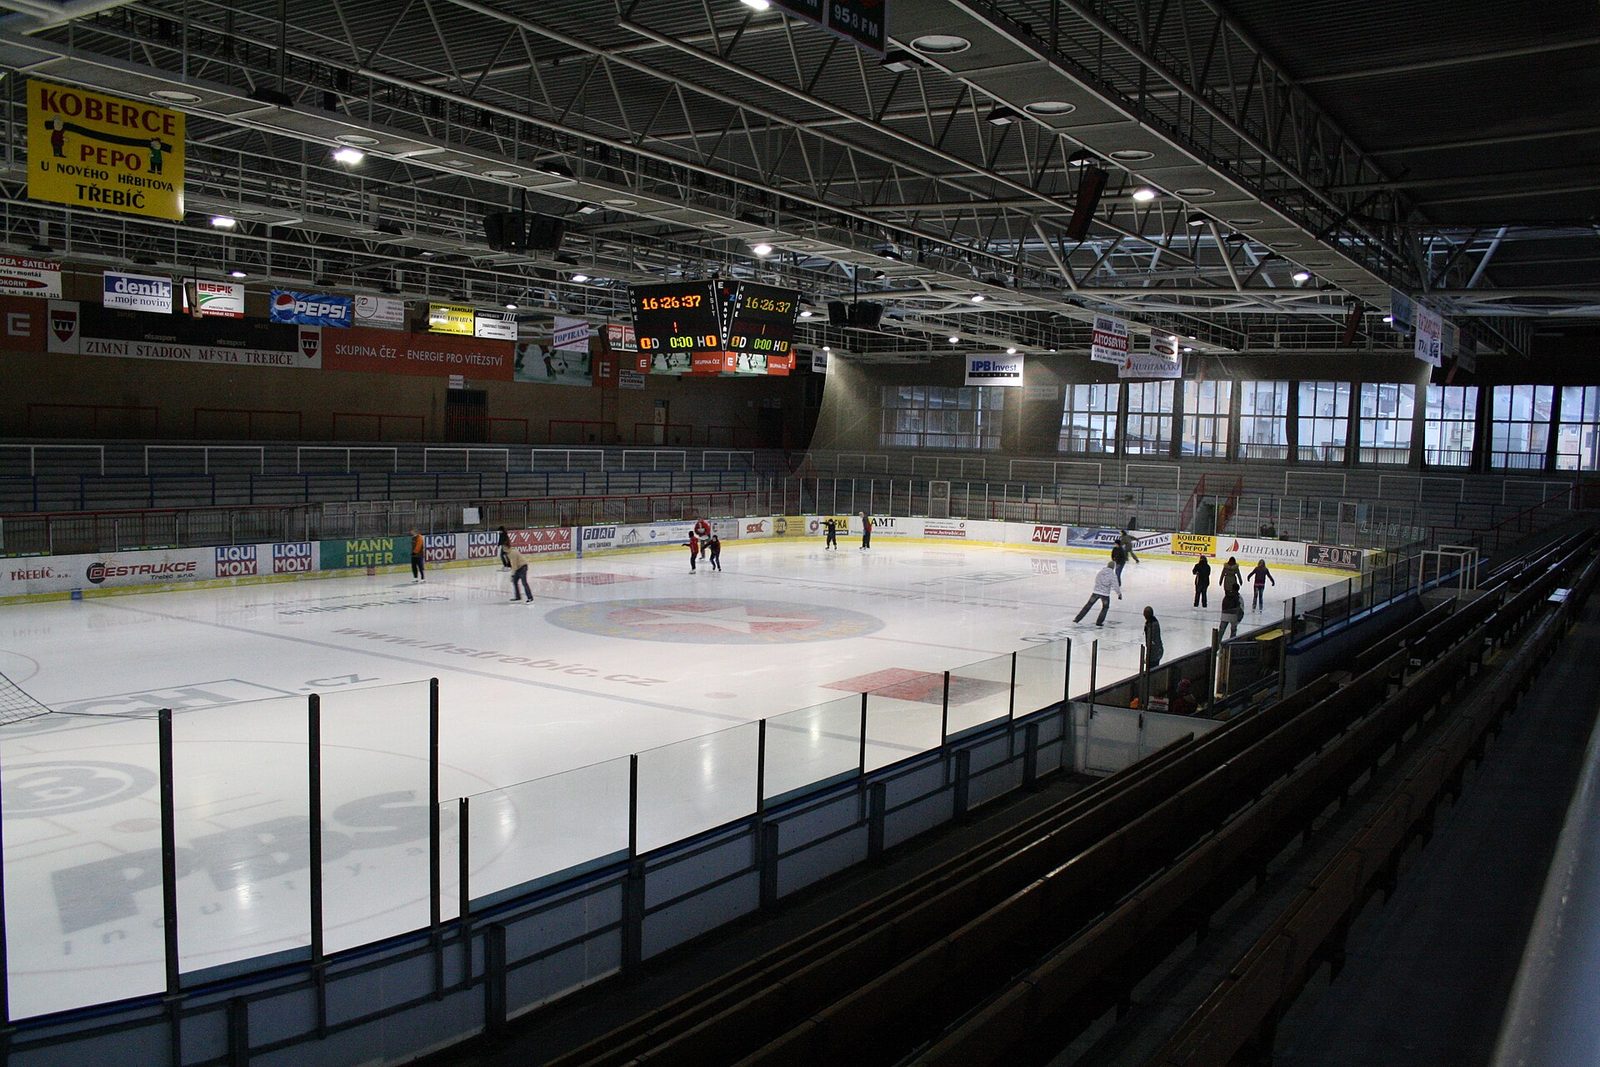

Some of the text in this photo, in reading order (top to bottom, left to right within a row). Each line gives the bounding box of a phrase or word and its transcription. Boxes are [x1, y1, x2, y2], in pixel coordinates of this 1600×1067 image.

[861, 18, 878, 38] FM
[40, 88, 176, 136] KOBERCE
[80, 144, 141, 170] PEPO
[40, 161, 174, 192] U NOVÉHO HŘBITOVA
[76, 184, 146, 208] TŘEBÍČ
[22, 260, 60, 270] SATELITY
[115, 278, 170, 298] deník
[140, 298, 172, 309] noviny
[630, 290, 638, 320] HOME
[642, 296, 701, 310] 16:26:37
[708, 284, 716, 316] VISIT
[734, 286, 744, 318] HOME
[746, 297, 790, 313] 16:26:37
[294, 301, 346, 320] PEPSI
[792, 294, 800, 324] VISIT
[554, 328, 588, 342] TOPTRANS
[652, 338, 660, 349] D
[670, 336, 694, 348] 0:00
[697, 336, 705, 346] H
[739, 337, 746, 348] D
[754, 338, 772, 350] 0:00
[774, 340, 780, 351] H
[86, 340, 128, 354] ZIMNÍ
[136, 345, 191, 358] STADION
[245, 352, 293, 364] TŘEBÍČE
[336, 344, 504, 366] SKUPINA ČEZ ENERGIE PRO VÍTĚZSTVÍ
[972, 361, 1016, 372] IPB Invest
[426, 534, 456, 548] LIQUI
[470, 532, 498, 544] LIQUI
[584, 528, 616, 540] FIAT
[1033, 530, 1060, 542] AVE
[1178, 534, 1211, 543] KOBERCE
[346, 539, 394, 552] MANN
[1132, 536, 1169, 548] OPTRANS
[217, 546, 256, 561] LIQUI
[274, 543, 311, 558] LIQUI
[426, 549, 456, 560] MOLY
[470, 546, 498, 558] MOLY
[1242, 544, 1299, 557] HUHTAMAKI
[274, 558, 312, 572] MOLY
[346, 552, 394, 566] FILTER
[10, 567, 54, 580] TŘEBÍČ
[90, 562, 196, 578] DESTRUKCE
[217, 562, 256, 576] MOLY
[333, 627, 669, 688] www.hstrebic.cz
